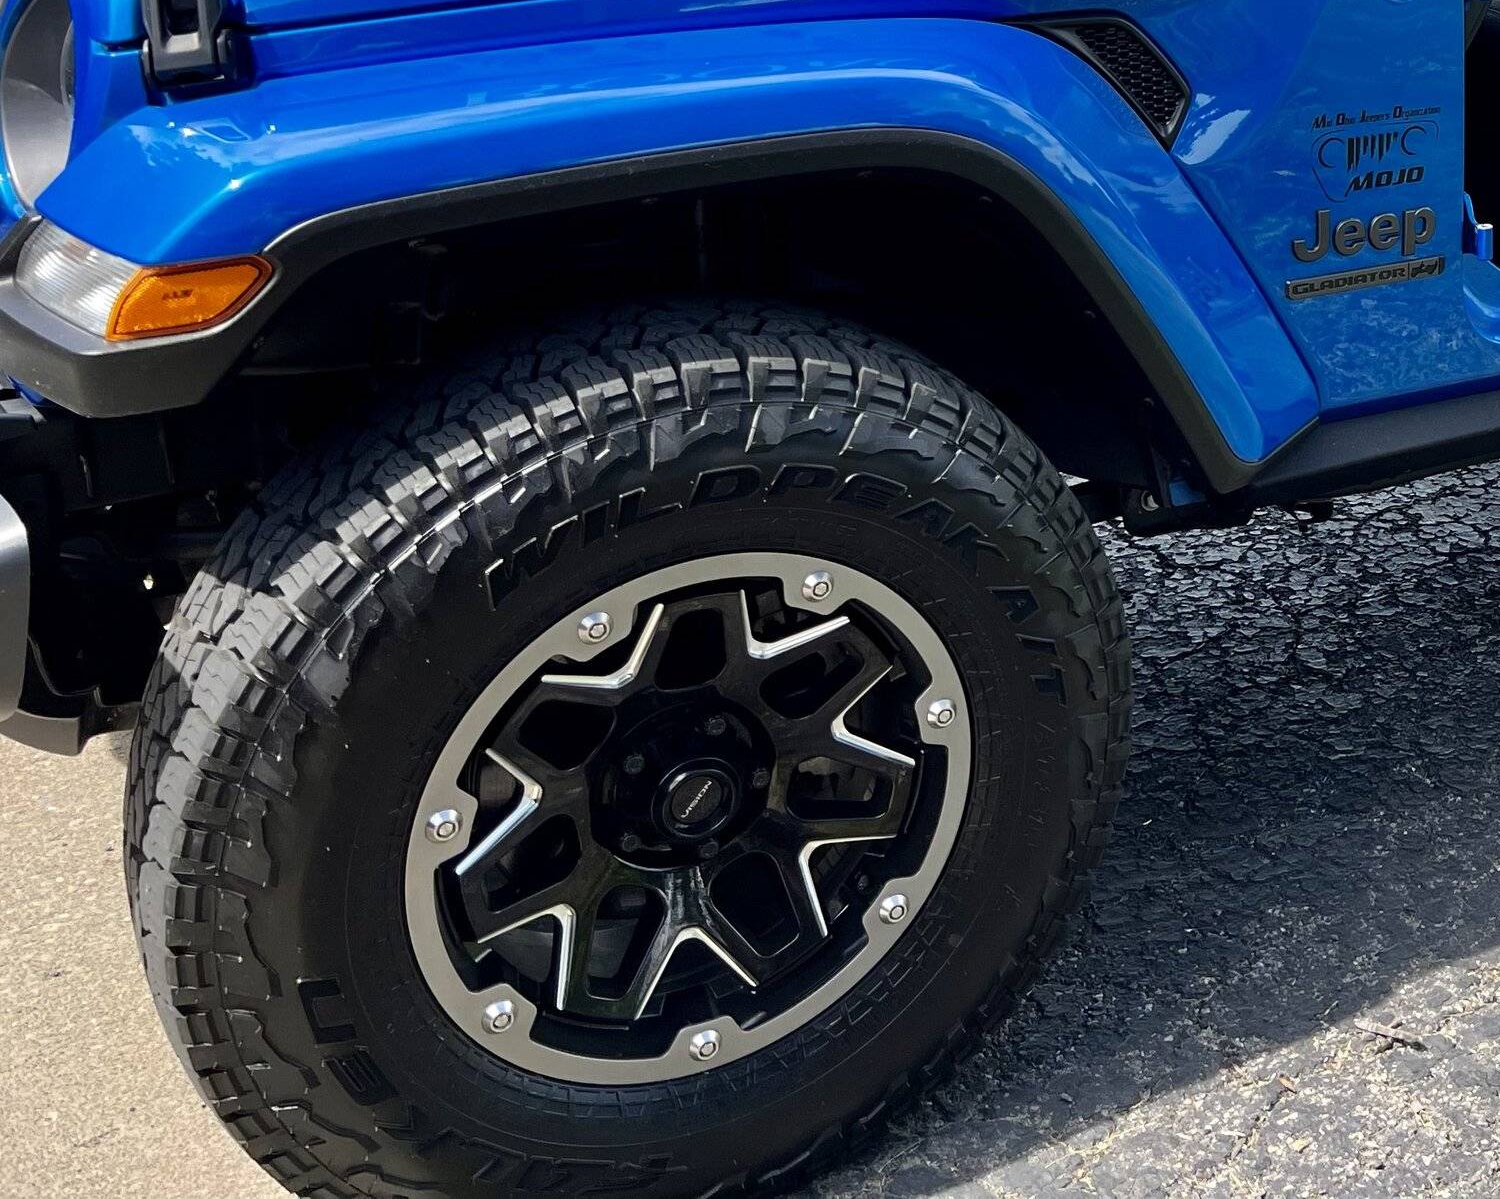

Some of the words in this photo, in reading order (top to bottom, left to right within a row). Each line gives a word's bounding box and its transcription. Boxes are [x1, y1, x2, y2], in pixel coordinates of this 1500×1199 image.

[1350, 166, 1424, 192] MOJO
[1291, 206, 1436, 263] Jeep
[1291, 266, 1406, 296] GLADIATOR
[481, 463, 1011, 612] WILDPEAK
[680, 779, 713, 819] VISION
